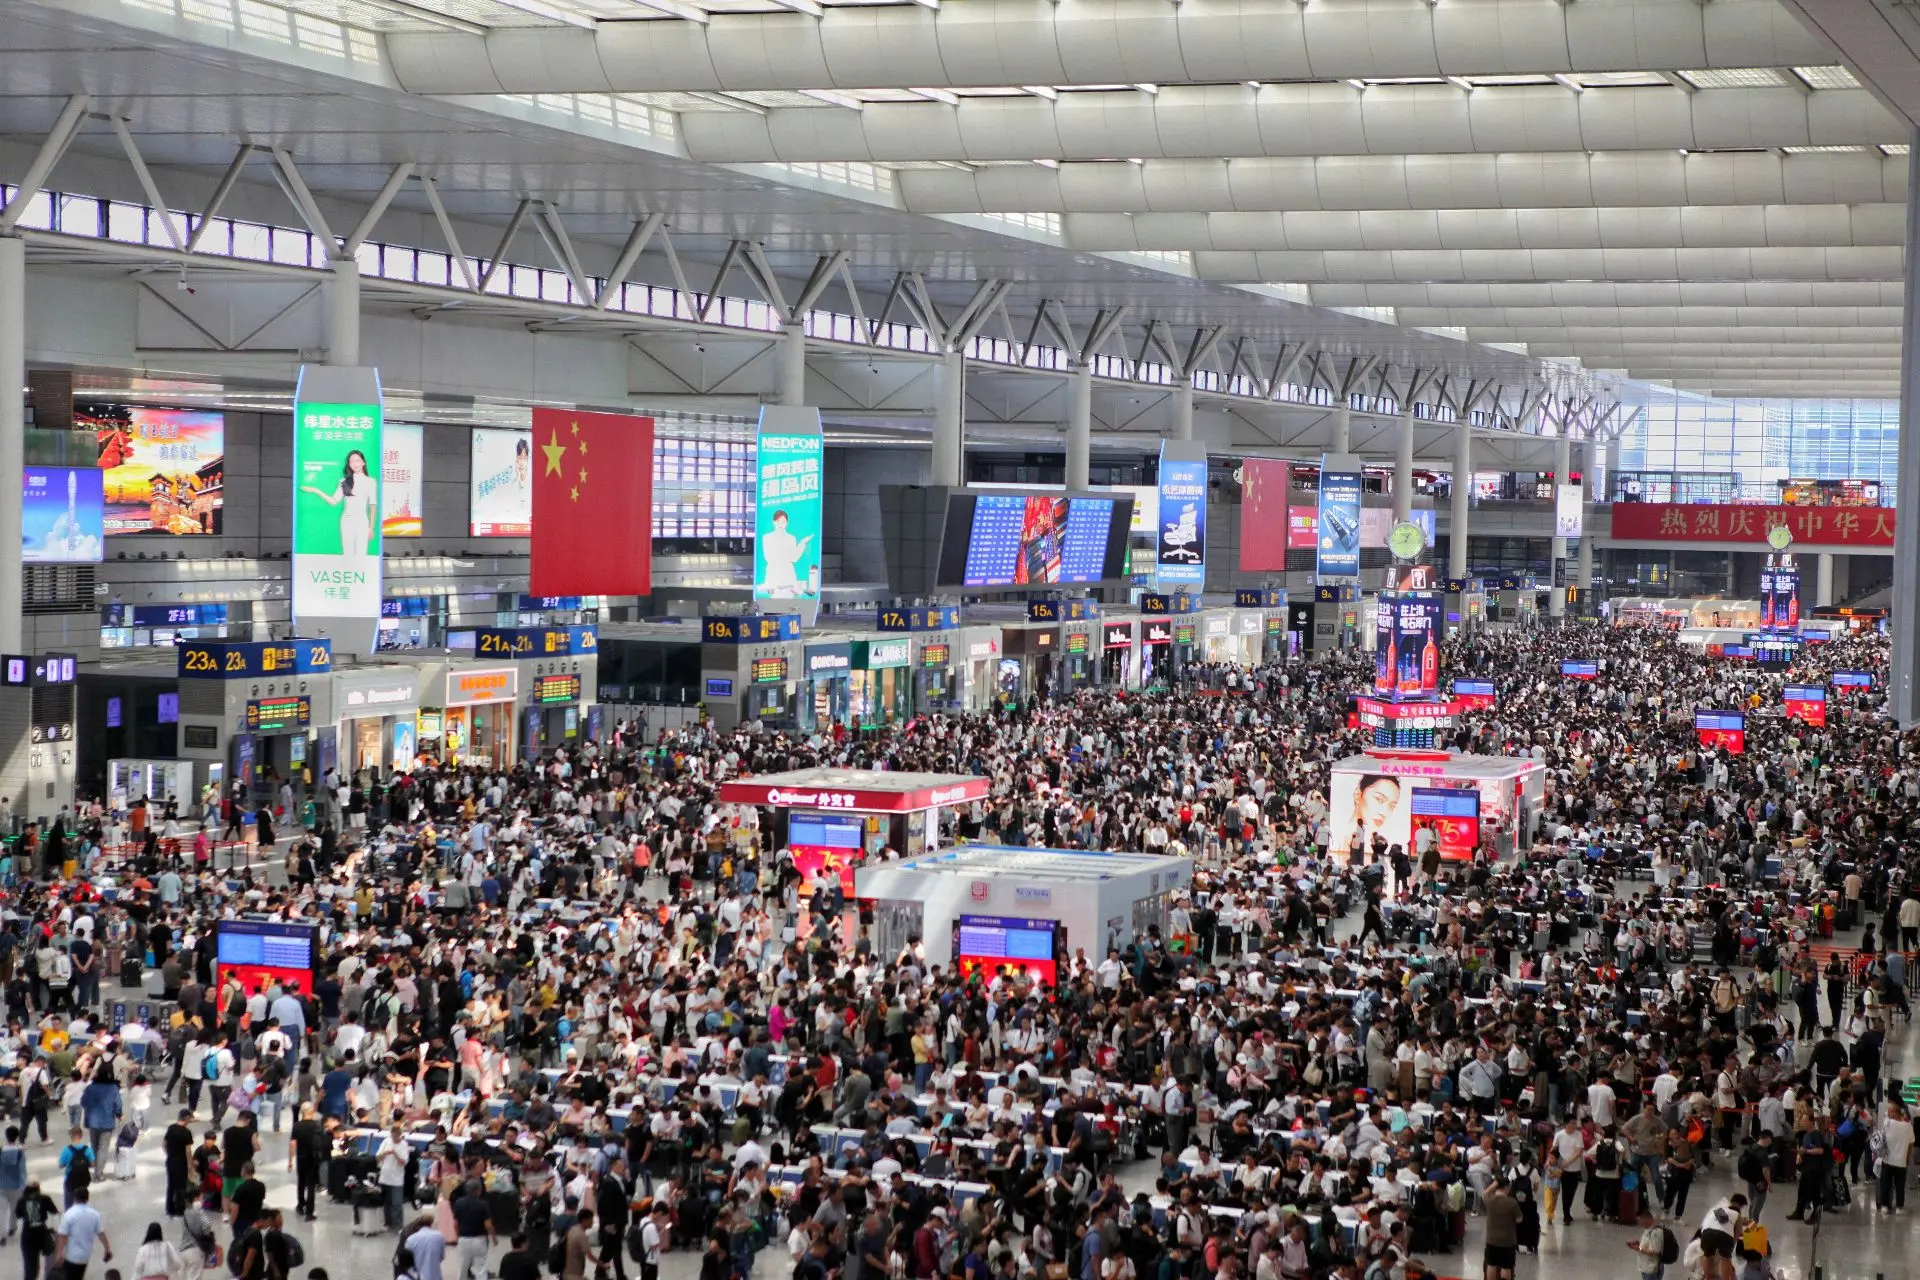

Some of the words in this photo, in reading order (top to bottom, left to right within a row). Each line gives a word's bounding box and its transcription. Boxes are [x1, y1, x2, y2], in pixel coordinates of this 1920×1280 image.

[303, 414, 374, 429] 伟星水生态
[761, 437, 820, 449] NEDFON
[310, 570, 366, 584] VASEN
[1504, 579, 1514, 588] 3A
[1321, 589, 1332, 599] 9A
[1450, 582, 1460, 591] 5A
[1145, 598, 1164, 611] 13A
[1240, 593, 1257, 604] 11A
[1032, 604, 1053, 617] 15A
[882, 612, 905, 627] 17A
[708, 622, 732, 637] 19A
[481, 634, 510, 652] 21A
[184, 650, 218, 671] 23A
[225, 651, 247, 671] 23A
[310, 646, 330, 666] 22A
[1801, 702, 1814, 717] 75
[1381, 765, 1419, 776] KANS
[818, 792, 856, 807] 外交官
[1437, 819, 1460, 845] 75
